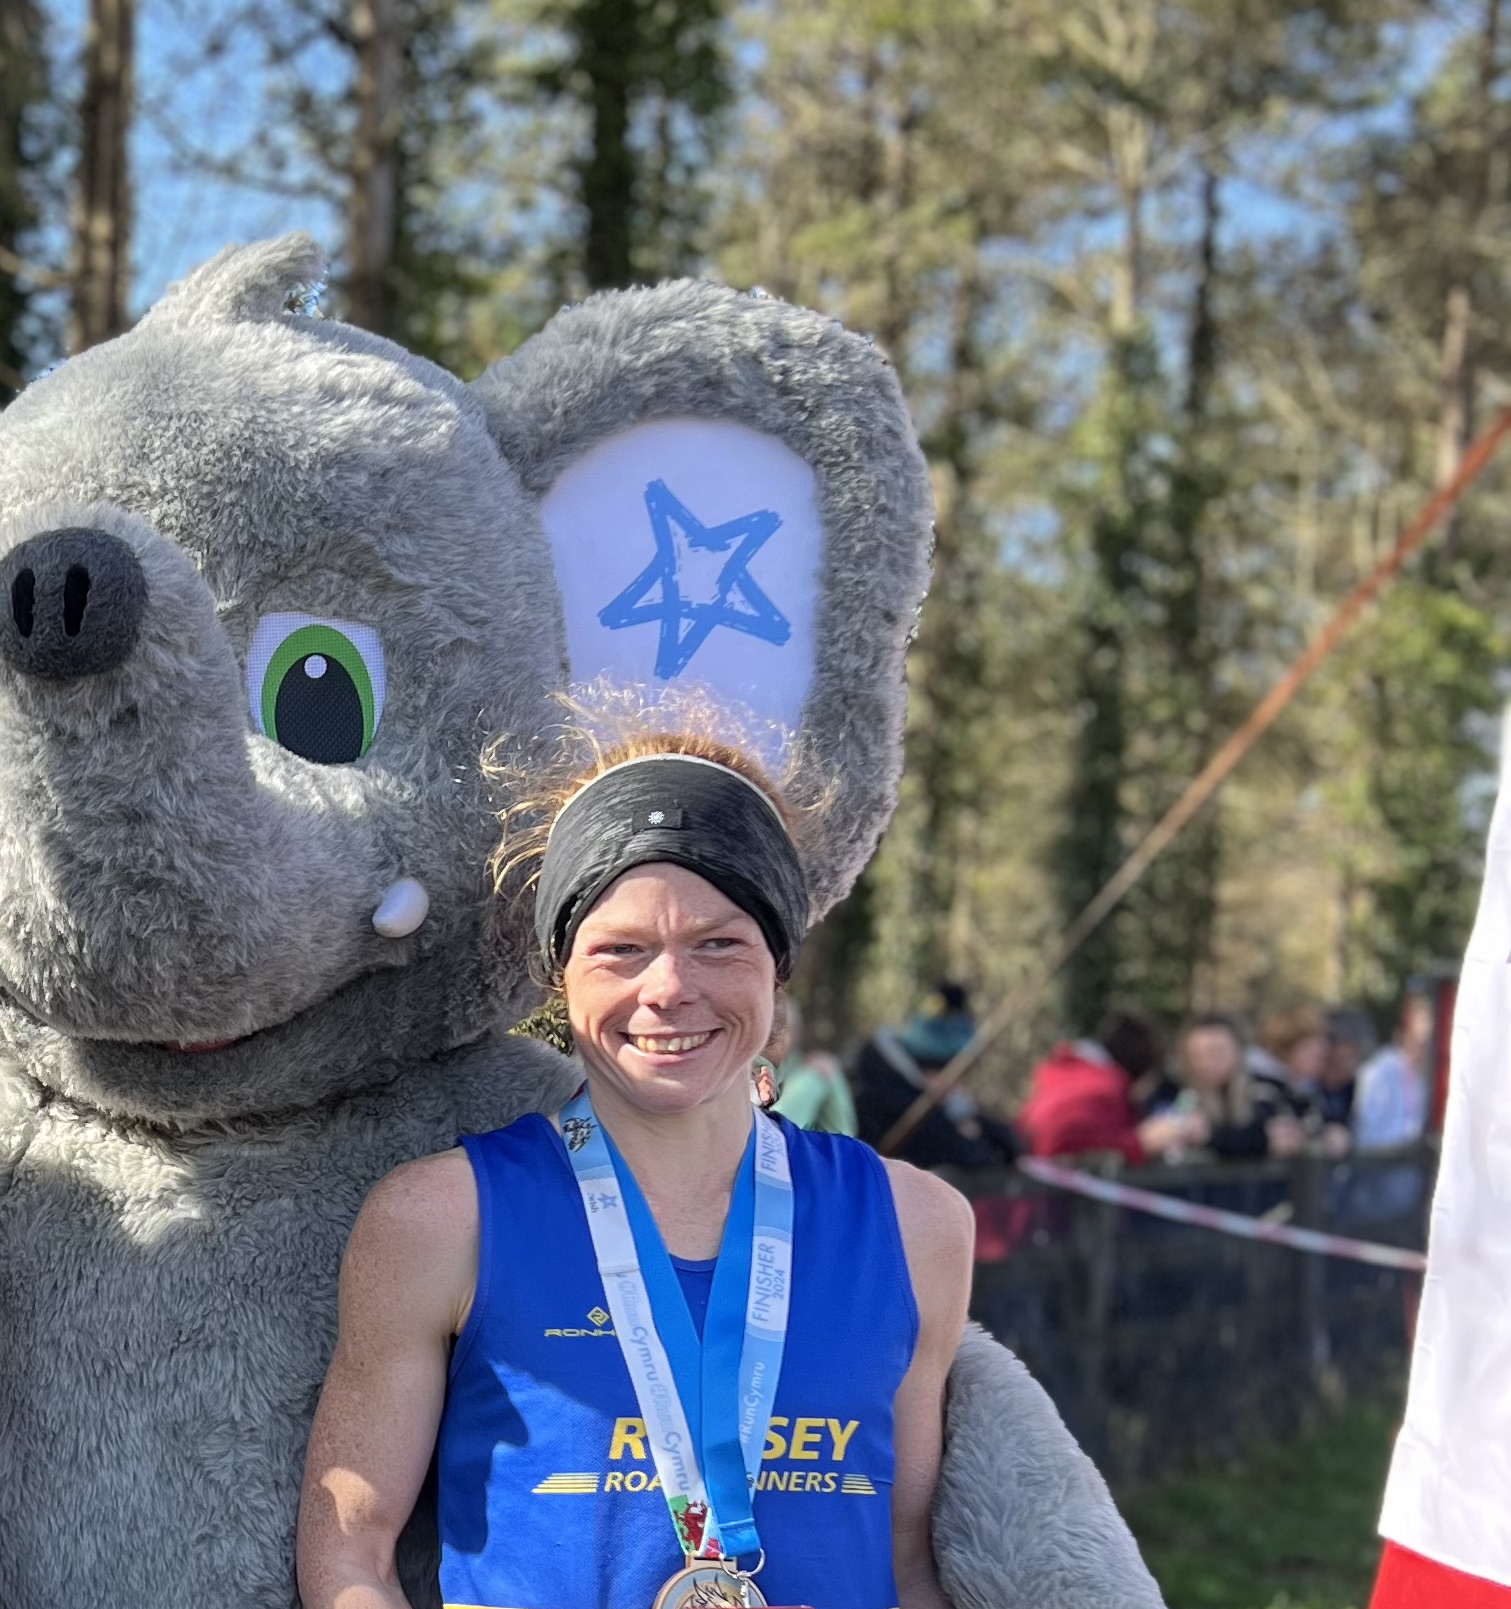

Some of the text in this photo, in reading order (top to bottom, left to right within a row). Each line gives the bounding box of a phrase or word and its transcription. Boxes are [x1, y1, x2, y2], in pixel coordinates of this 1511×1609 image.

[752, 1242, 776, 1323] FINISHER
[772, 1269, 786, 1300] 2024
[544, 1328, 616, 1337] RONH
[608, 1417, 860, 1461] RSEY
[604, 1471, 838, 1493] ROA NNERS
